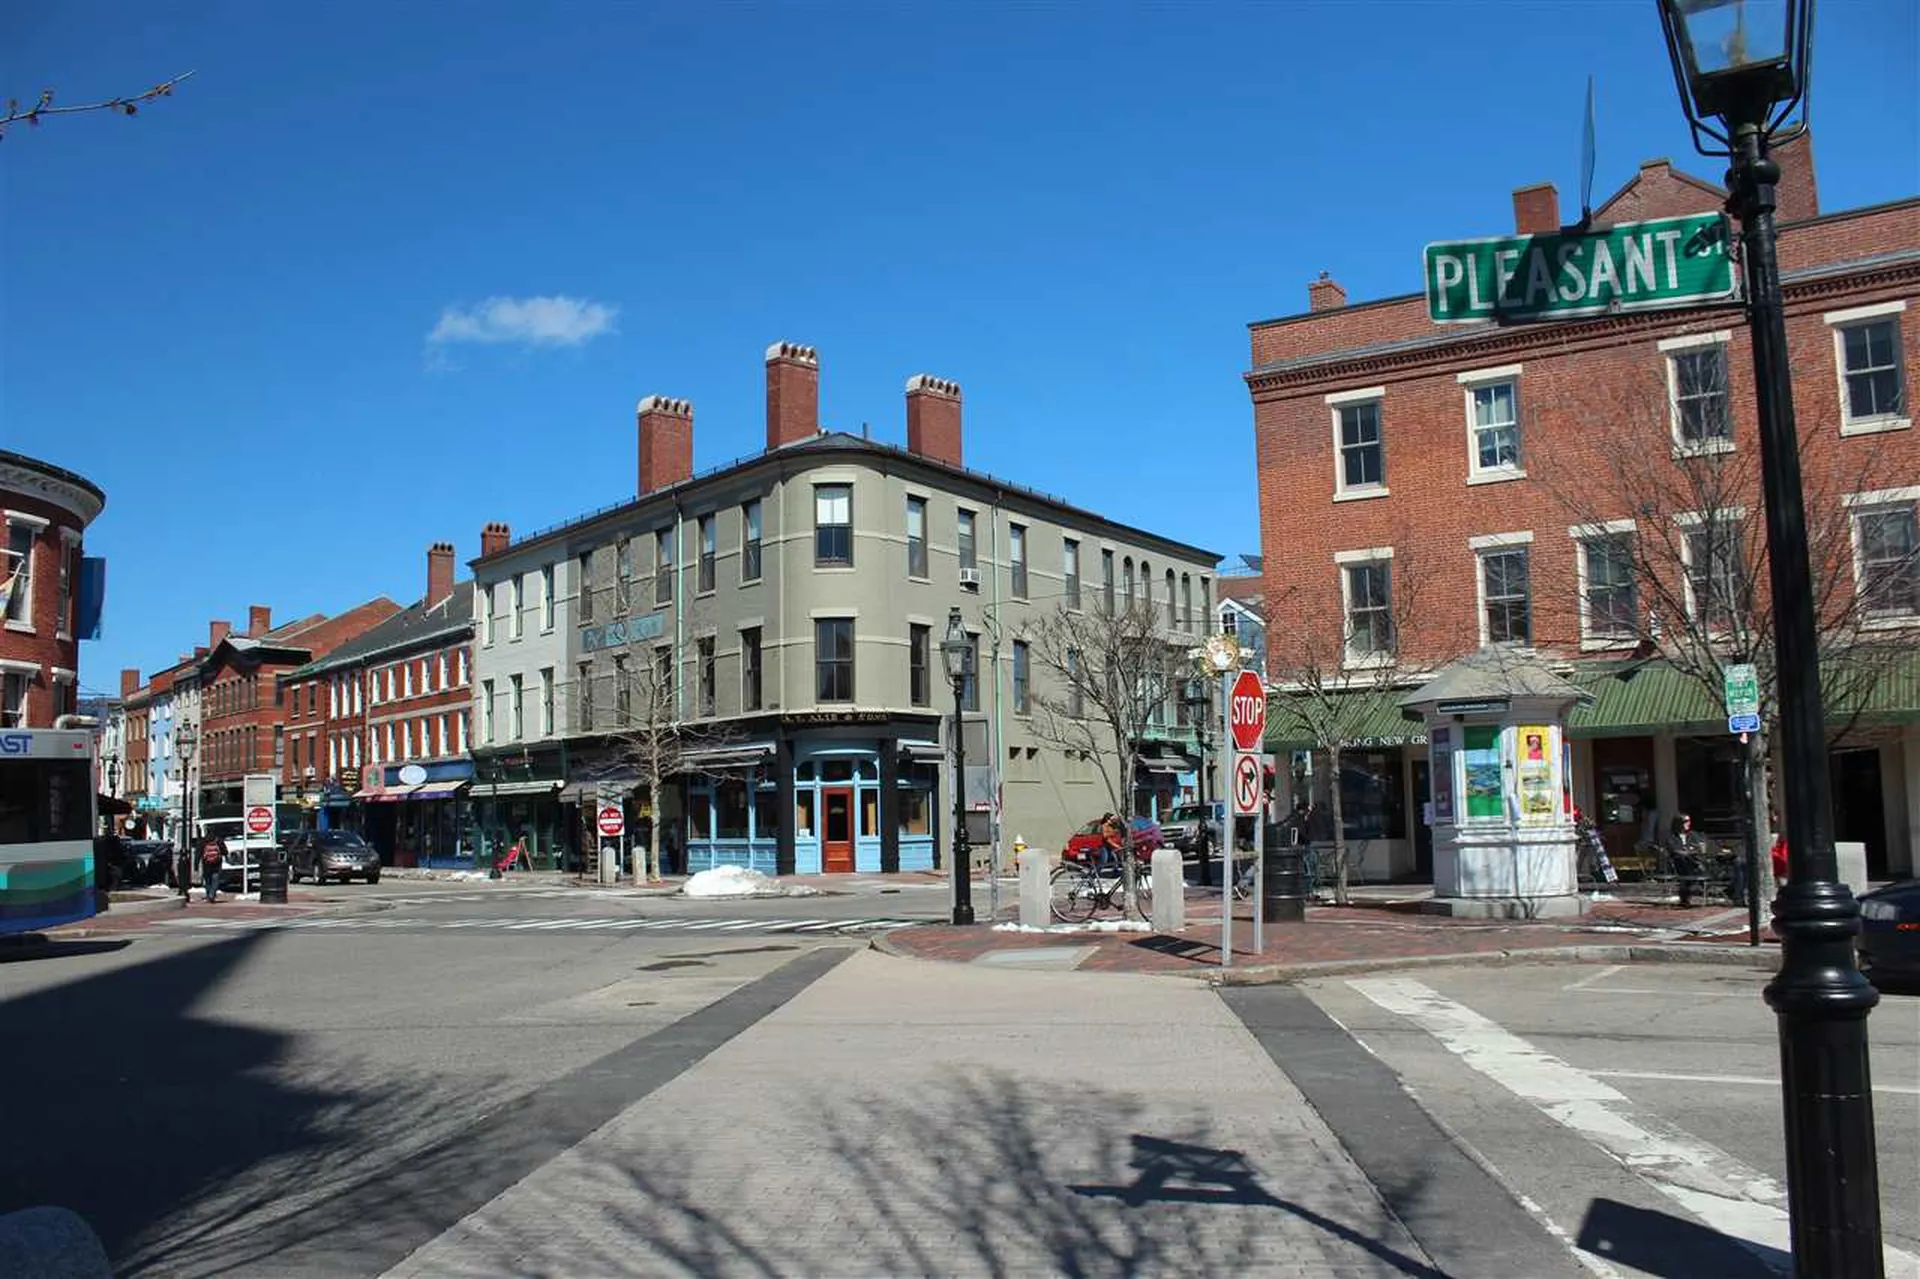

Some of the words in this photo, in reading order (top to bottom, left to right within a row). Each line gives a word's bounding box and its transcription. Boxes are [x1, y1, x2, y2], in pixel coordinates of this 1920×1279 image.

[1436, 230, 1682, 313] PLEASANT
[1233, 695, 1263, 725] STOP
[1380, 735, 1405, 747] NEW
